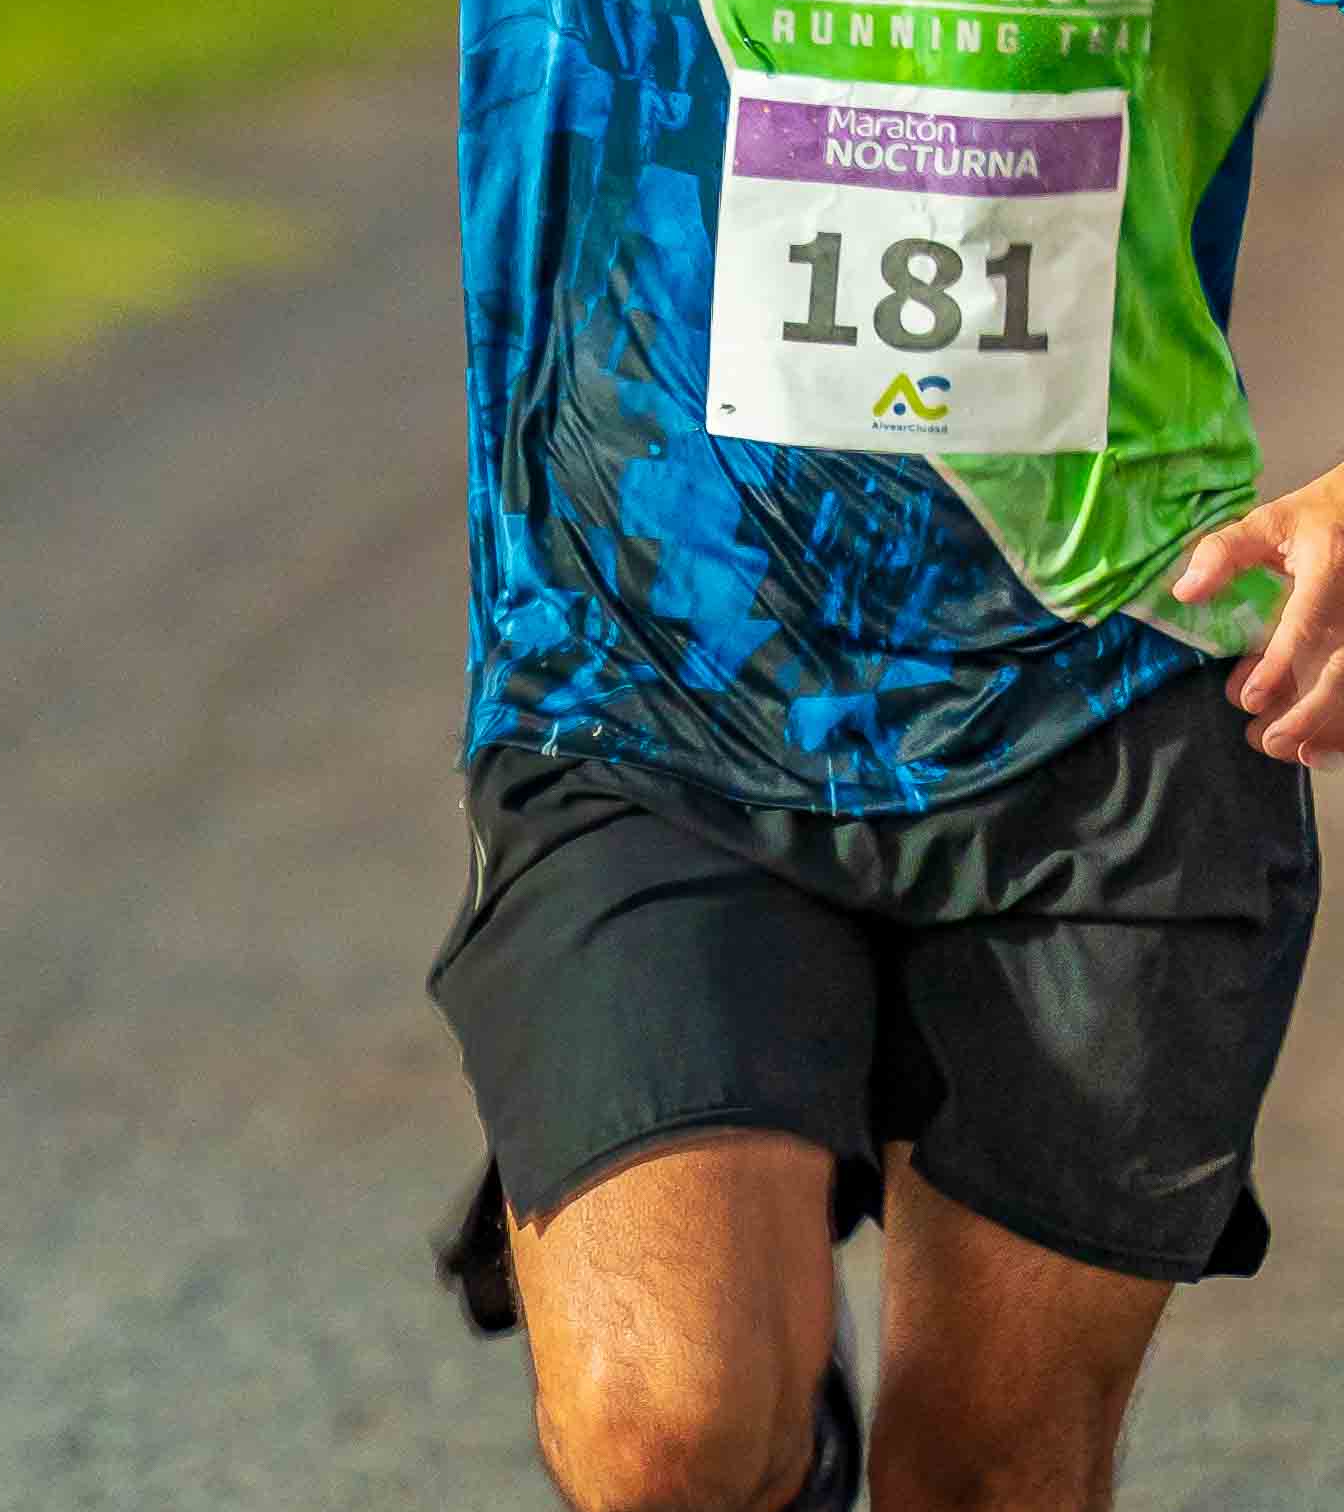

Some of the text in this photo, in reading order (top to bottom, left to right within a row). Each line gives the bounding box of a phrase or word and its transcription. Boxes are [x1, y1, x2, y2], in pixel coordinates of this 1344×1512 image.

[772, 9, 1020, 54] RUNNING
[827, 106, 956, 143] Maratón
[825, 137, 1039, 179] NOCTURNA
[782, 231, 1048, 353] 181
